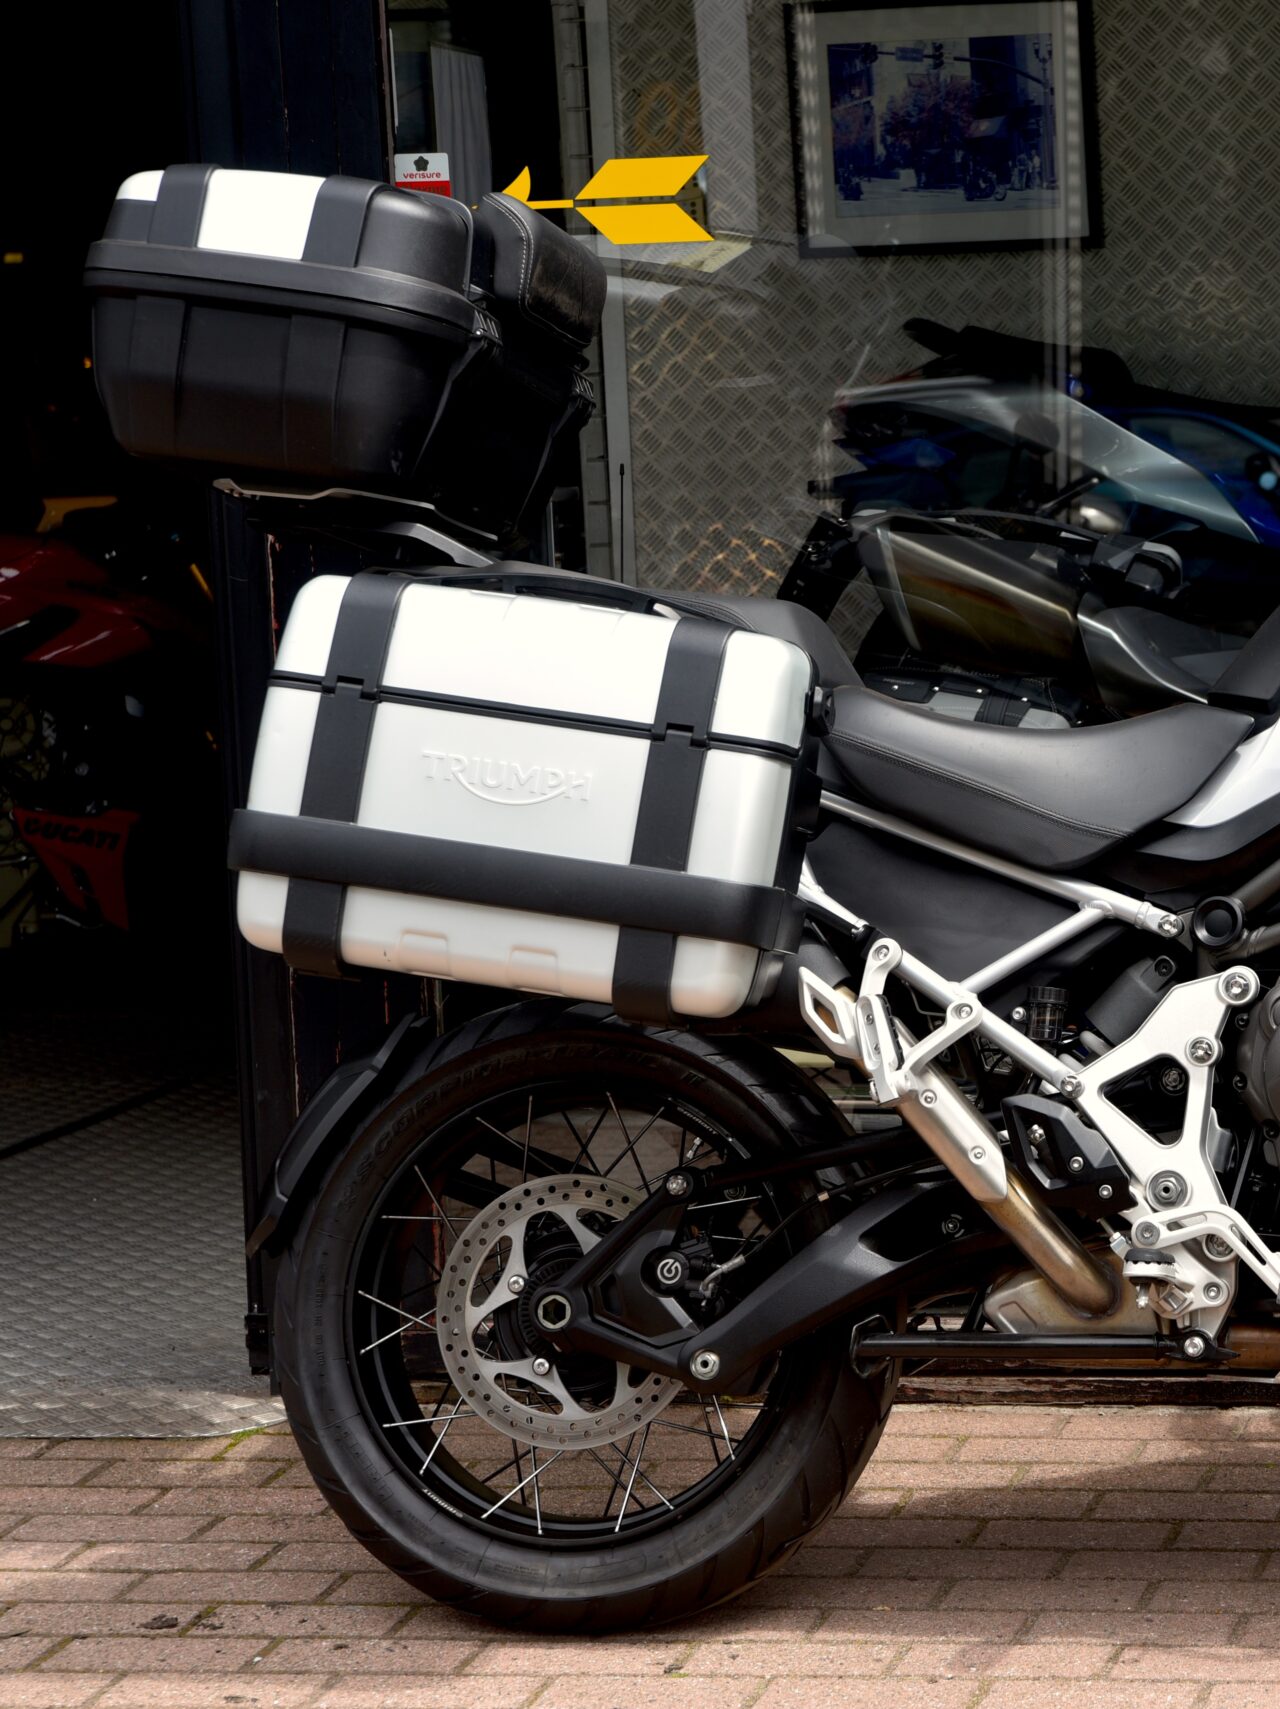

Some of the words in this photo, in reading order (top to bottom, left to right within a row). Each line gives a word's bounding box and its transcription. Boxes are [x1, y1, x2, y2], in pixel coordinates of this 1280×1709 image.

[402, 171, 442, 180] verisure
[422, 751, 592, 805] TRIUMPH
[24, 816, 121, 851] DUCATI
